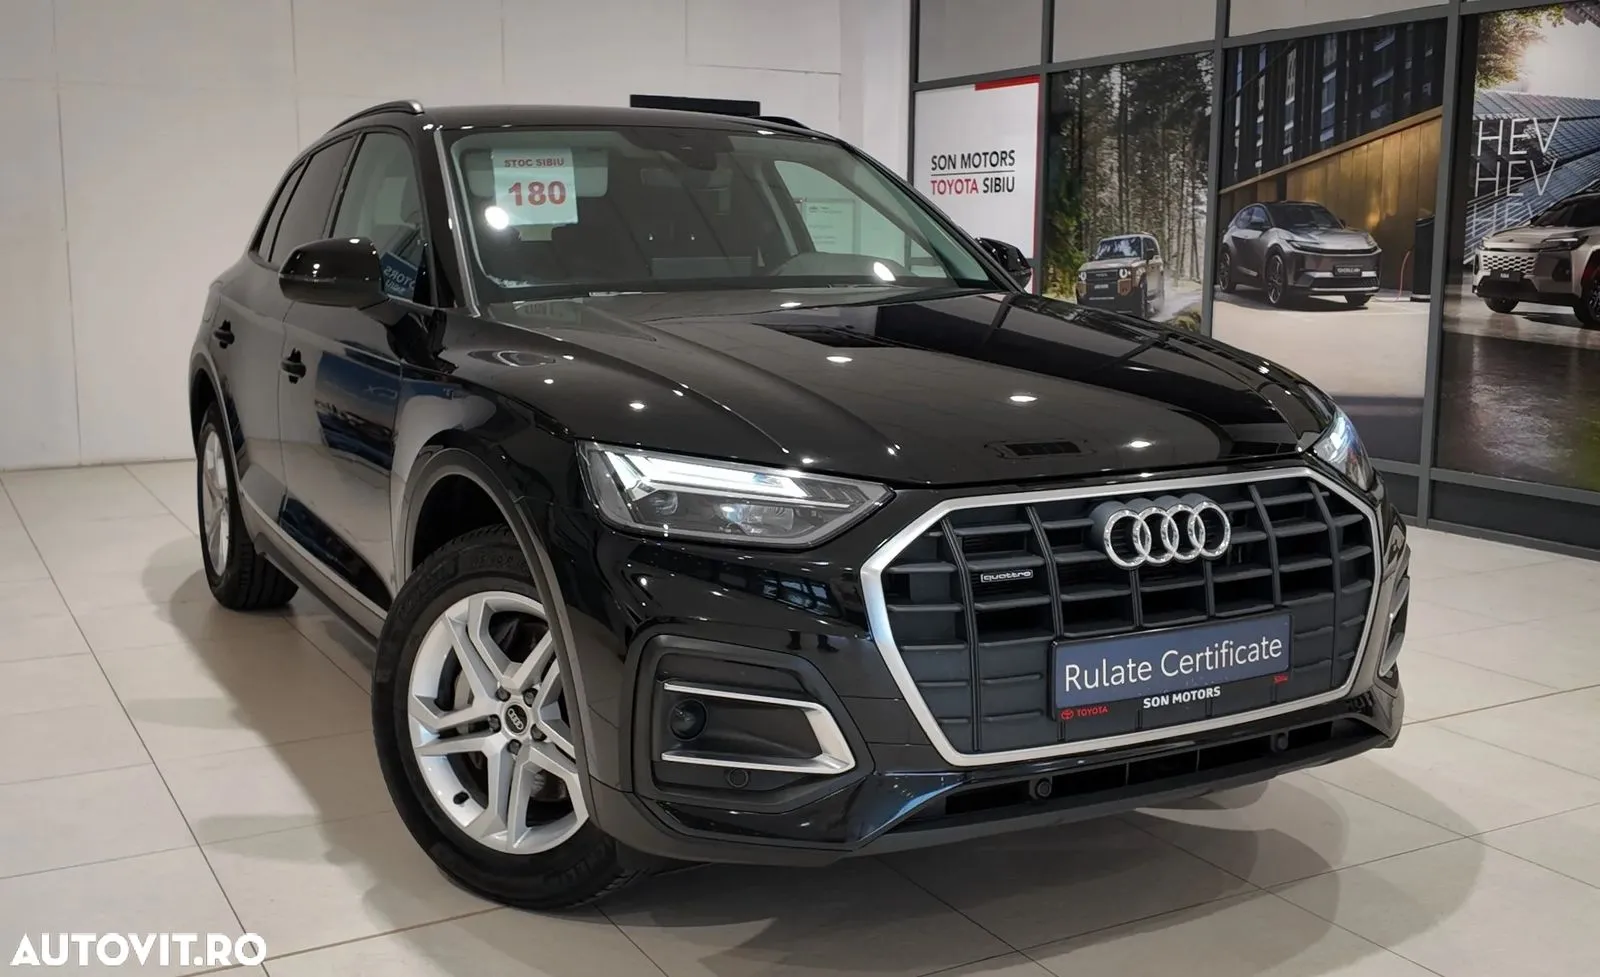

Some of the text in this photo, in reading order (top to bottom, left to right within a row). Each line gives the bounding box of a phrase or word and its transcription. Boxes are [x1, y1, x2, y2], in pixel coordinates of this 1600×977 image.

[1477, 115, 1560, 156] HEV
[504, 158, 564, 167] STOC SIBIU
[931, 149, 1016, 171] SON MOTORS
[931, 177, 1015, 195] TOYOTA SIBIU
[1474, 158, 1558, 197] HEV
[508, 181, 566, 206] 180
[983, 571, 1031, 581] quattro
[1064, 636, 1282, 692] Rulate Certificate
[1143, 686, 1221, 709] SON MOTORS
[1076, 706, 1108, 717] TOYOTA
